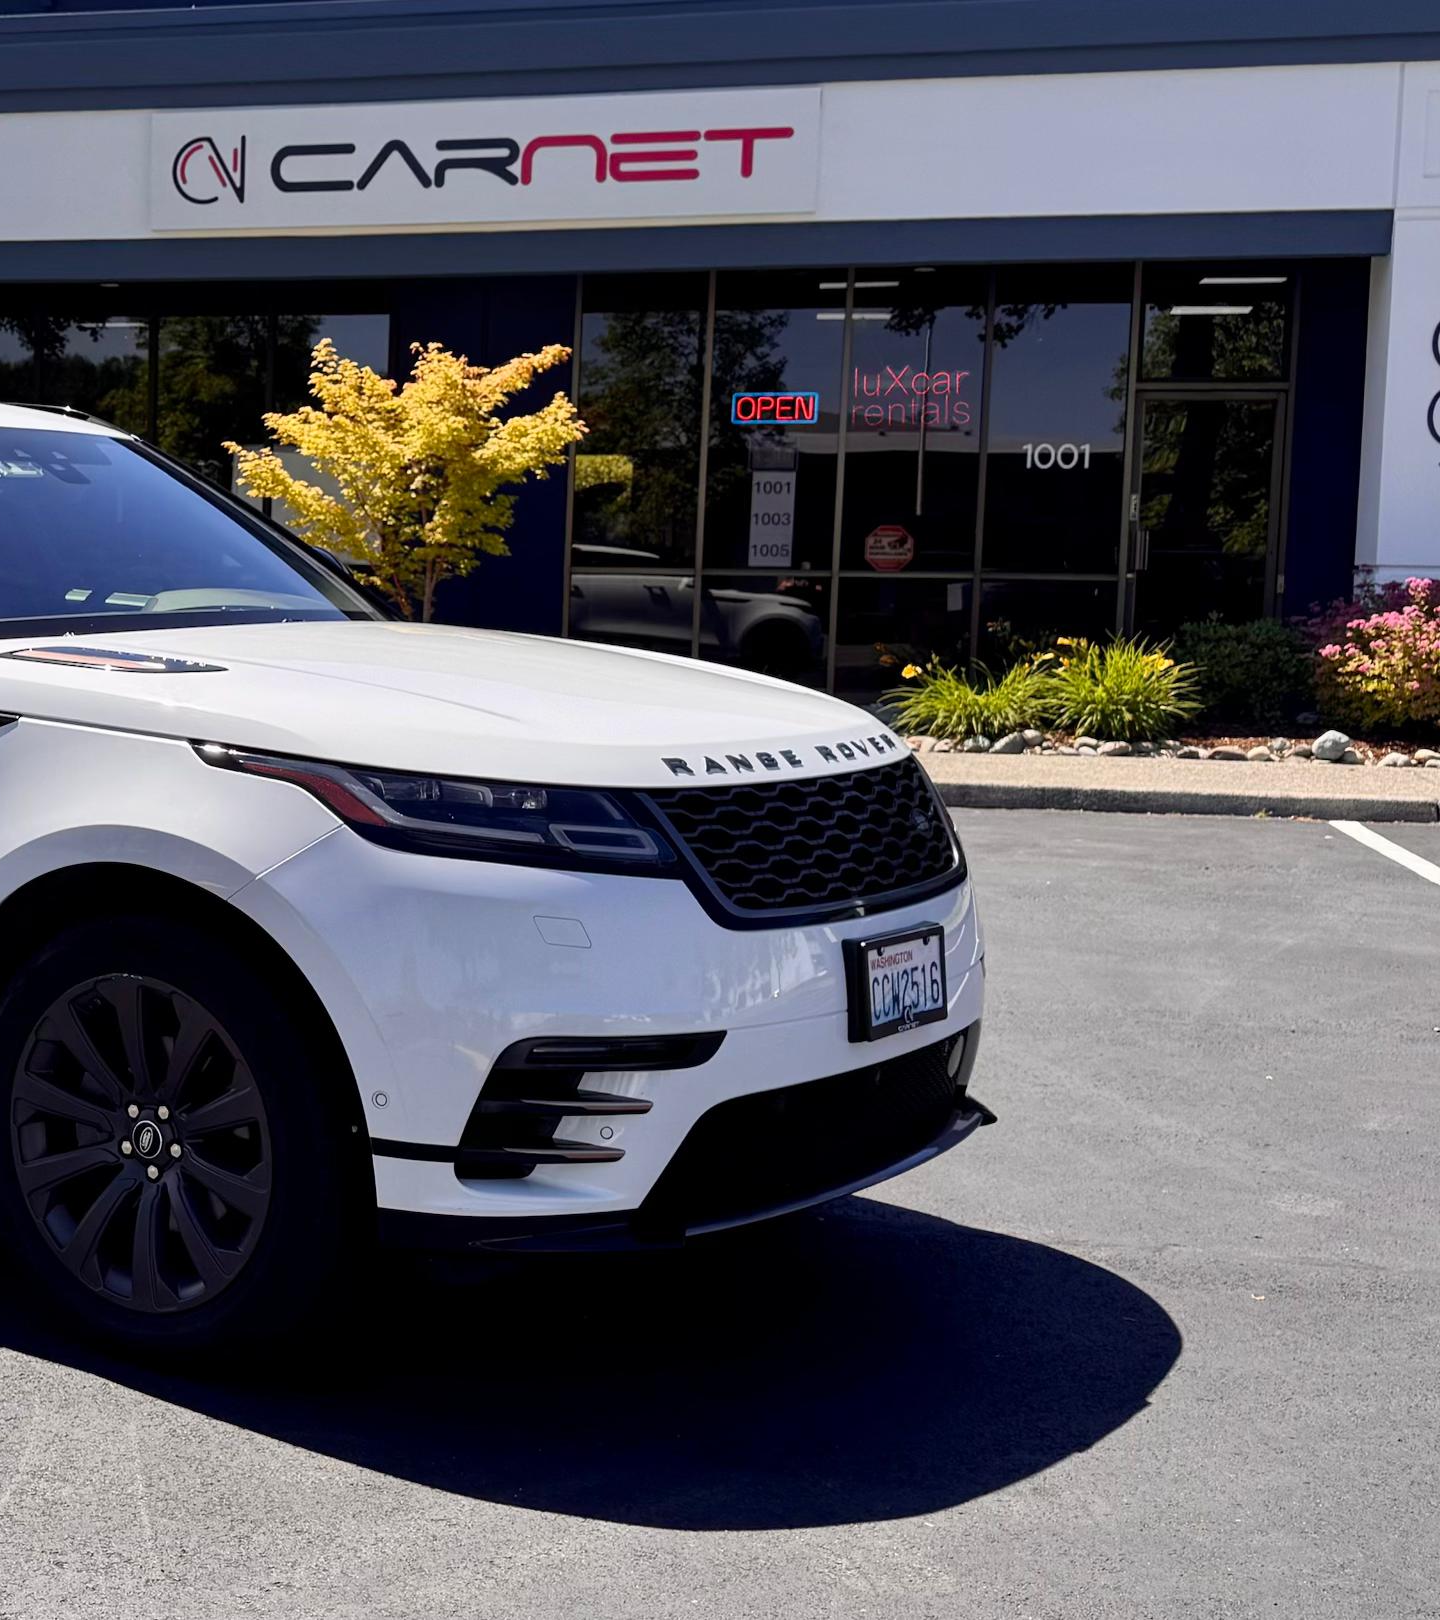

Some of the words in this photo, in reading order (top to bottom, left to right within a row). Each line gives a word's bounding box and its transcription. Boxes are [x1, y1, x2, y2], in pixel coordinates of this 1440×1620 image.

[271, 127, 794, 192] CARNET
[736, 396, 814, 421] OPEN
[851, 395, 971, 426] rentals
[1022, 442, 1090, 469] 1001
[755, 481, 791, 494] 1001
[753, 512, 791, 526] 1003
[751, 544, 790, 557] 1005
[662, 749, 803, 776] RANGE
[814, 733, 896, 763] ROVER
[871, 950, 913, 970] WASHINGTON
[872, 961, 940, 1021] CCW2516
